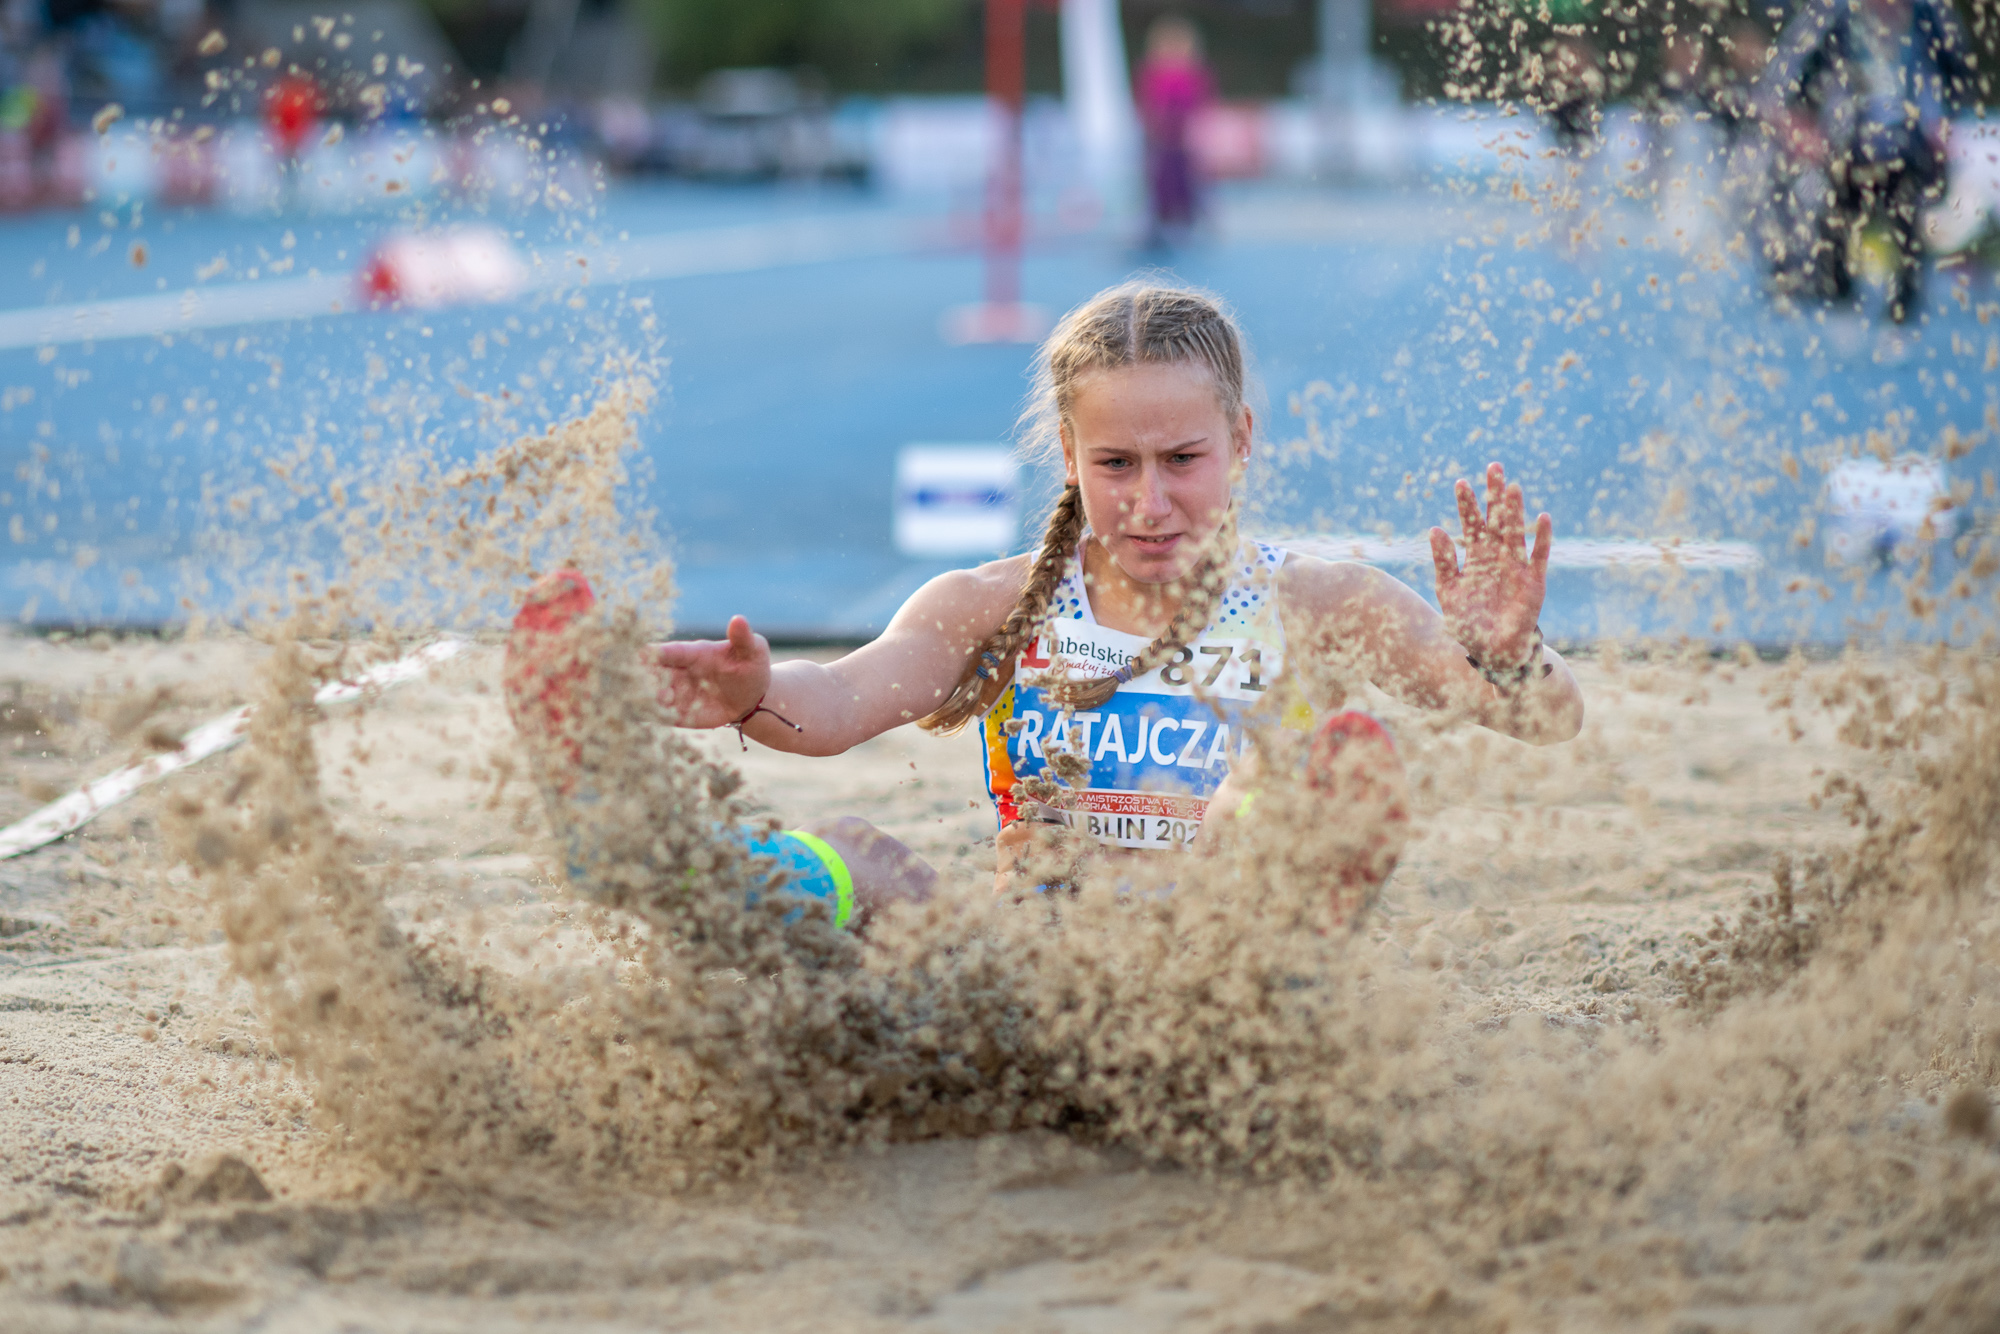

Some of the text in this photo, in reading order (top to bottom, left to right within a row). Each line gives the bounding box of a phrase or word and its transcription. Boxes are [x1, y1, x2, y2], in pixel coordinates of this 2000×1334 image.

[1159, 645, 1268, 692] 871
[1086, 794, 1161, 806] MISTRZOSTWA
[1162, 798, 1199, 810] POSKI
[1115, 804, 1165, 814] JANUSZA
[1155, 819, 1200, 845] 202
